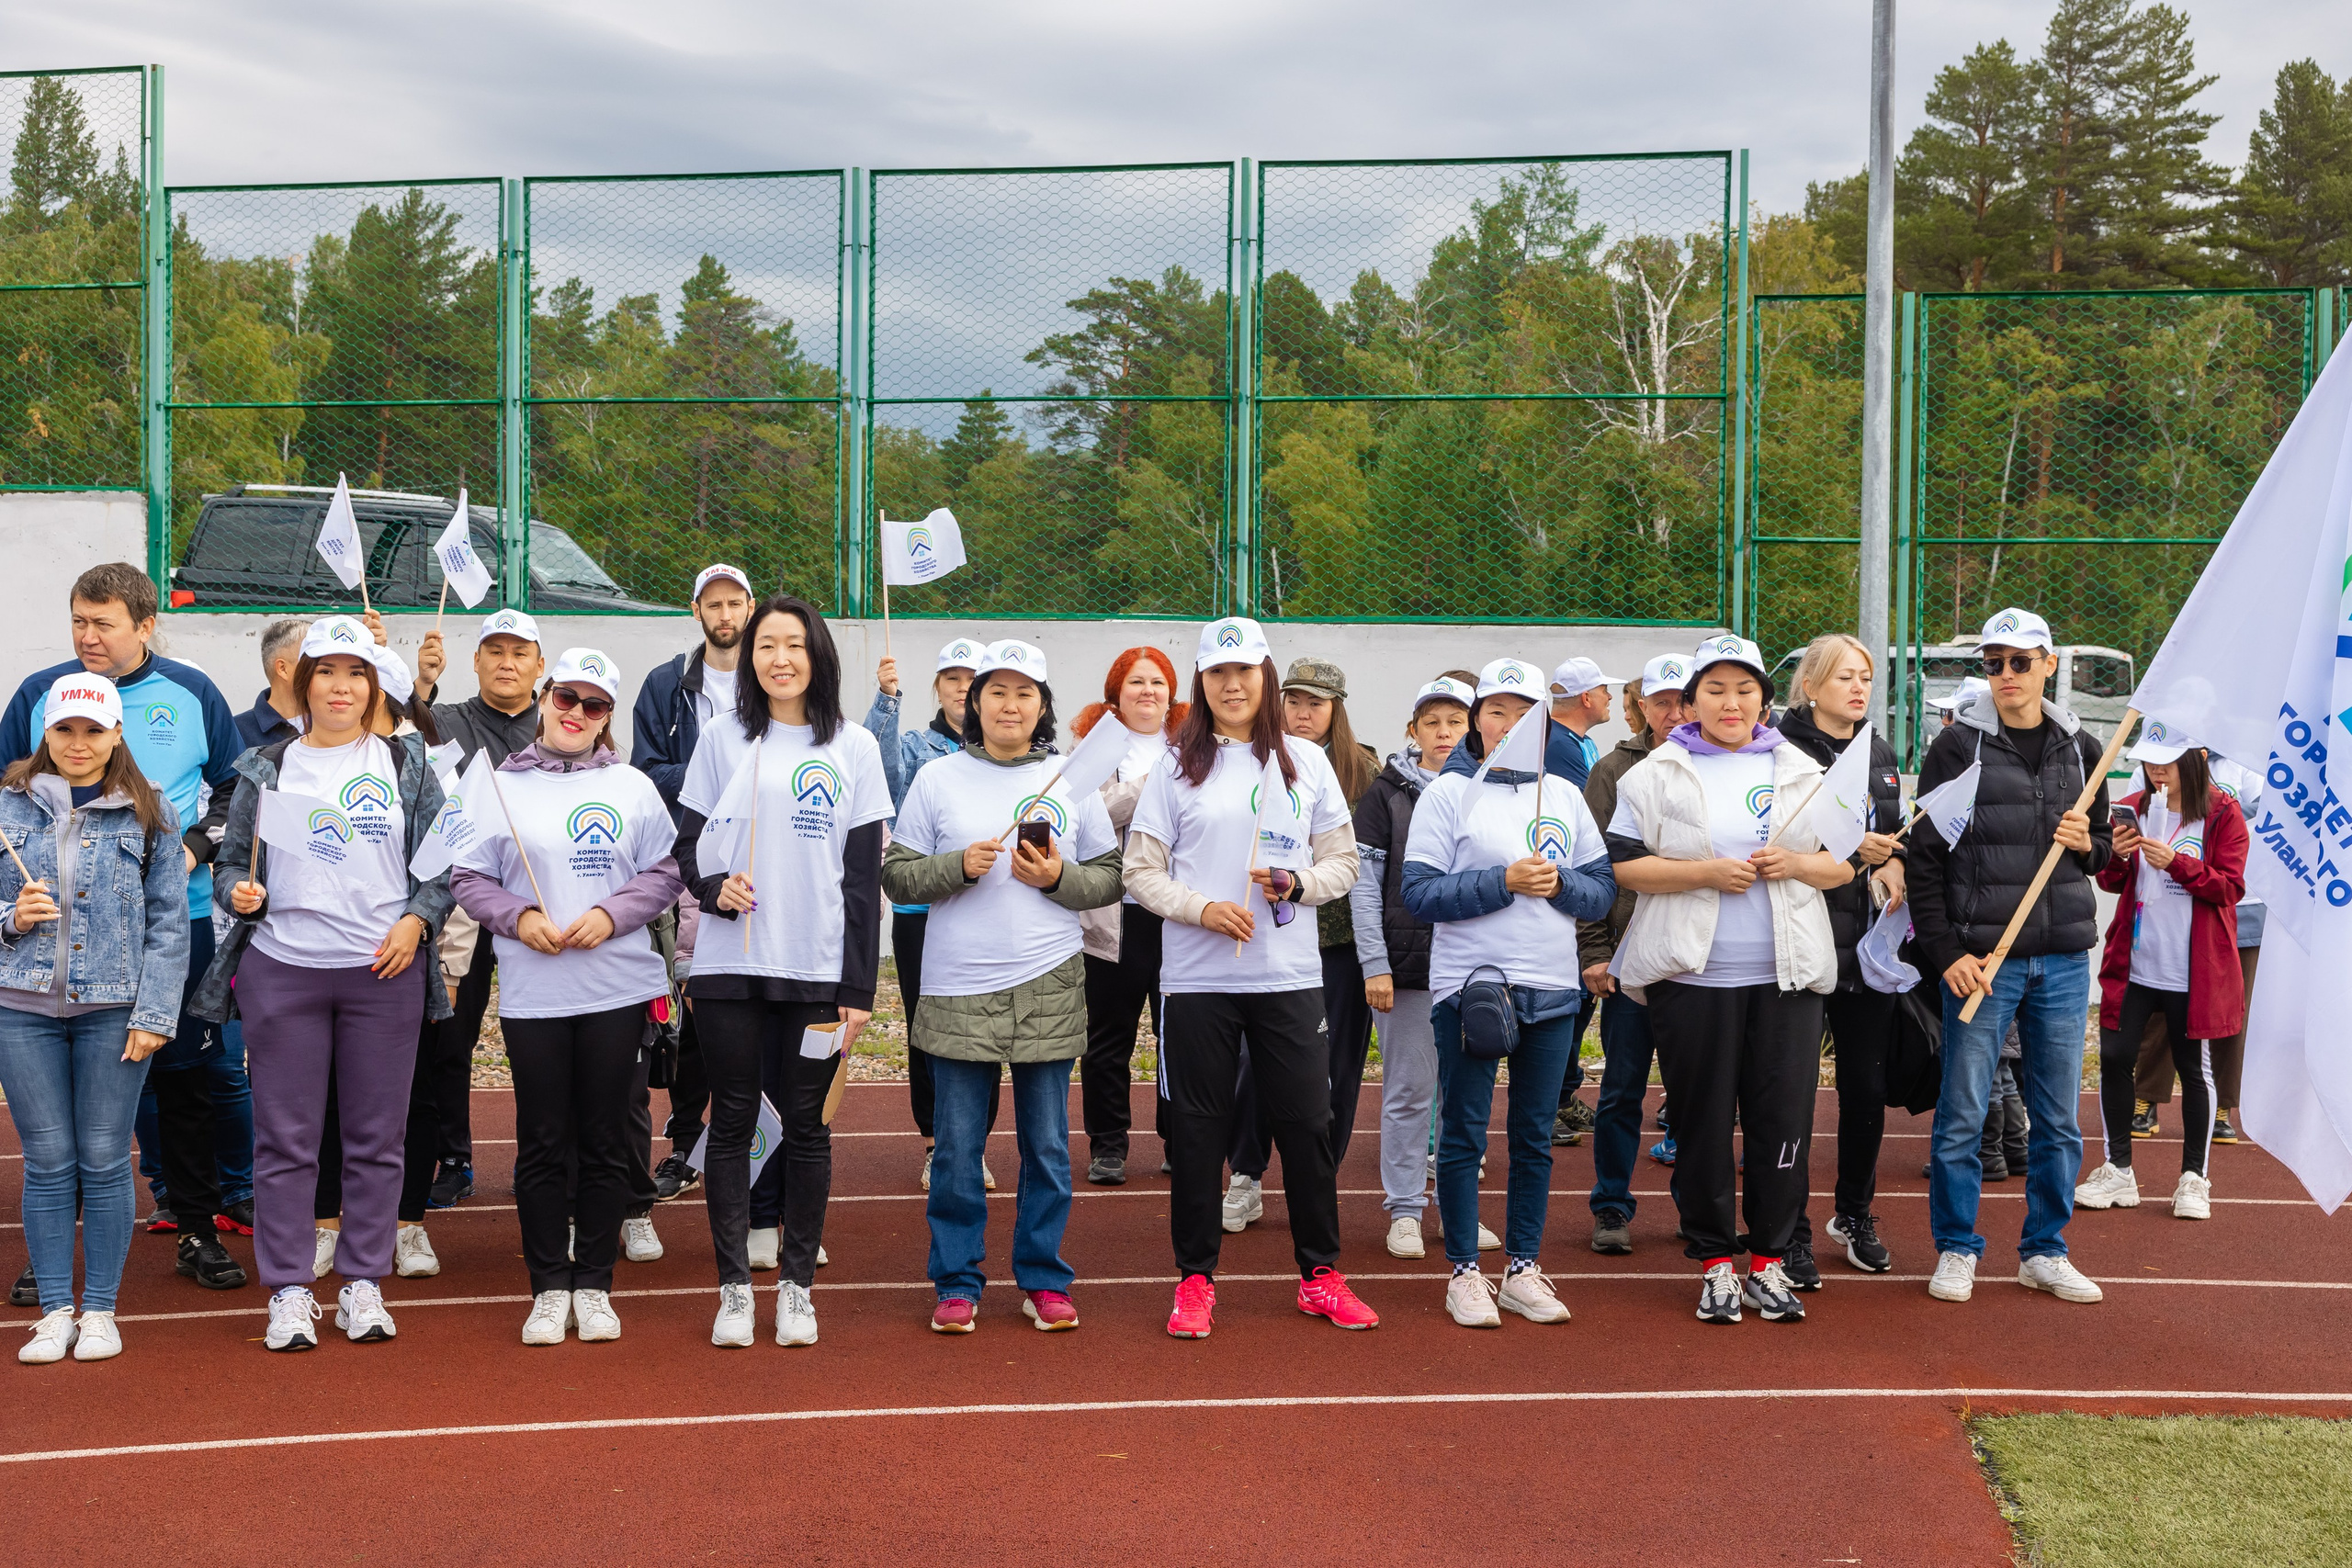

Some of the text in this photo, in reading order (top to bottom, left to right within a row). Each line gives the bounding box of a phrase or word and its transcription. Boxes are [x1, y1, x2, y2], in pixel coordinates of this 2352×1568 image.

[705, 567, 736, 578] УМЖИ
[61, 688, 105, 704] УМЖИ
[306, 841, 347, 857] ГОРОДСКОГО
[313, 840, 342, 851] КОМИТЕТ
[308, 846, 343, 861] ХОЗЯЙСТВА
[2255, 811, 2316, 898] Улан-
